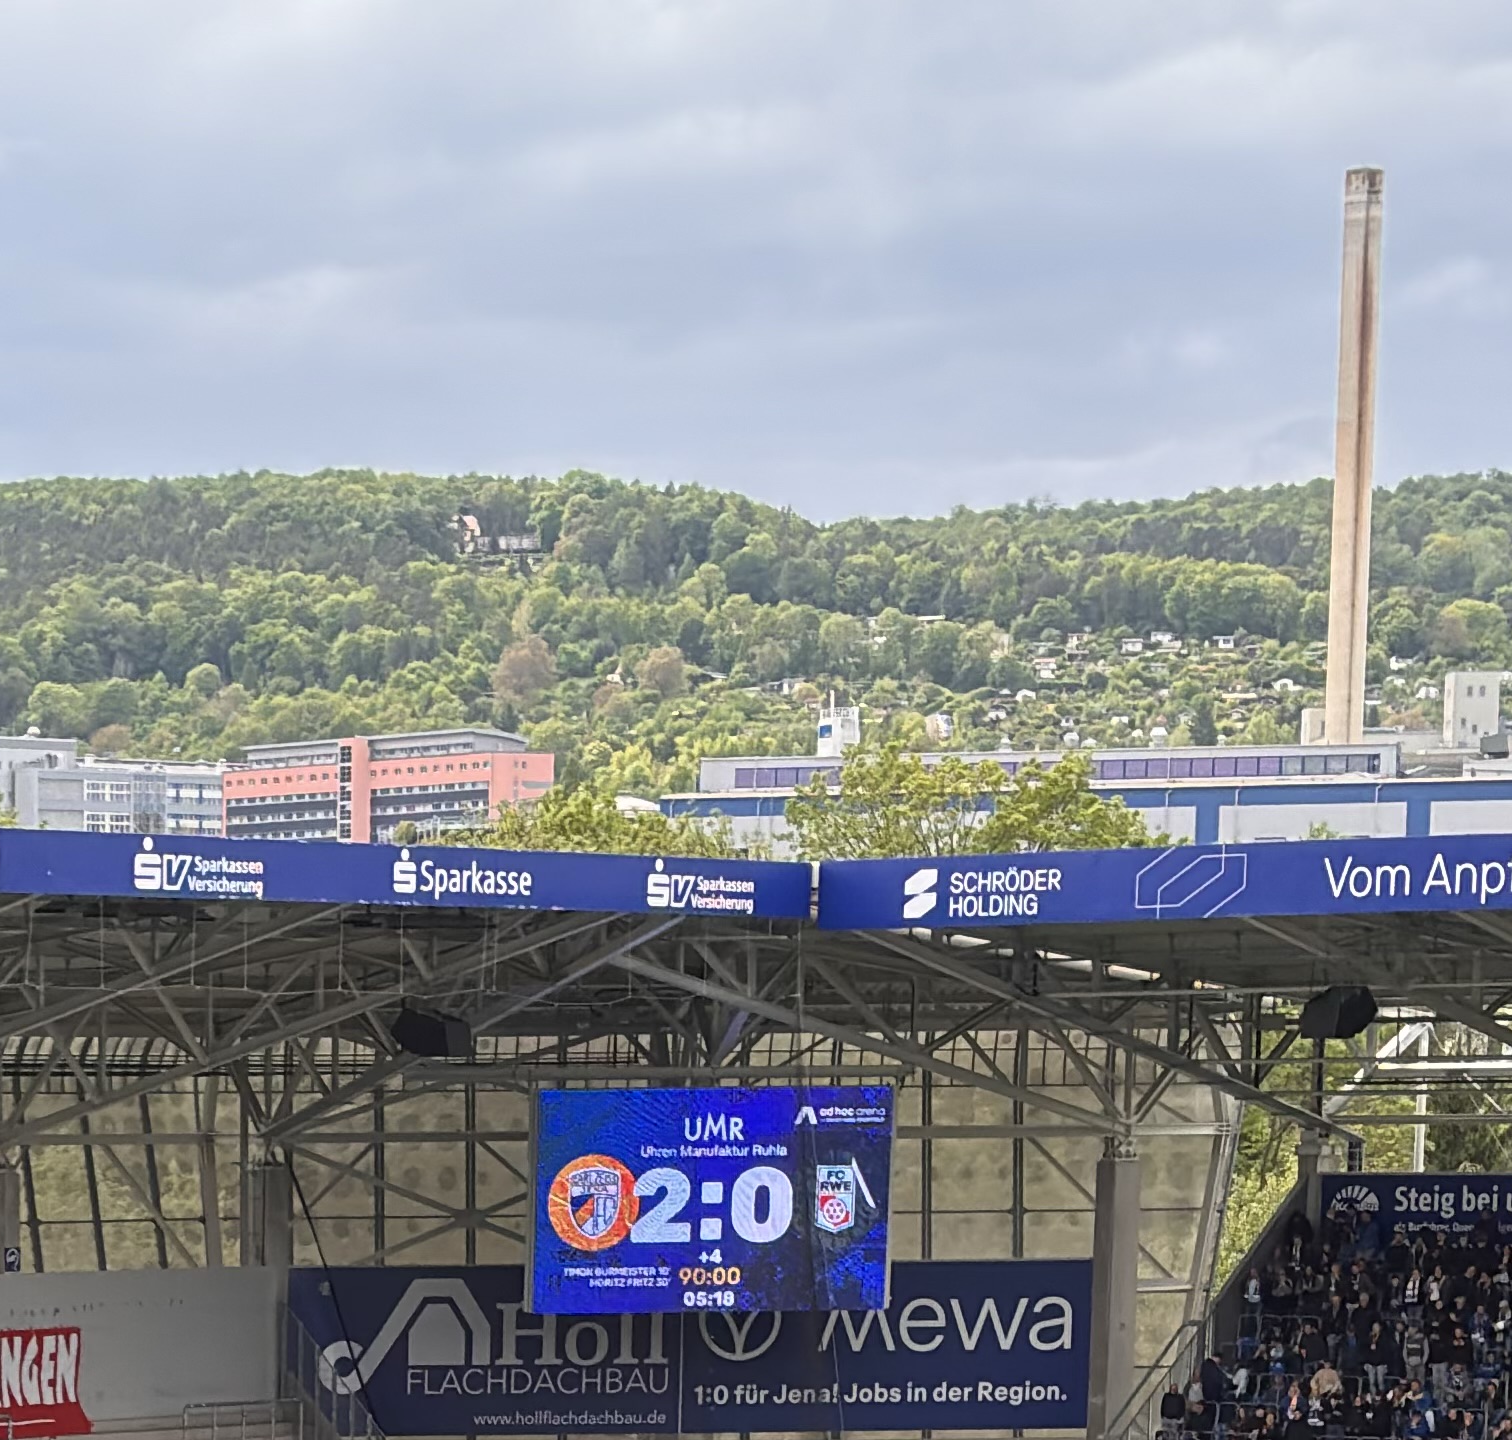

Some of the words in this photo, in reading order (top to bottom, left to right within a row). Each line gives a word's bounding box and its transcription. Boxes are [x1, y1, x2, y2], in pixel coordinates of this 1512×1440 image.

[193, 854, 264, 878] Sparkassen
[949, 865, 1061, 894] SCHRÖDER
[1324, 856, 1413, 899] Vom
[187, 874, 264, 898] Versicherung
[420, 859, 532, 902] Sparkasse
[695, 875, 755, 896] Sparkassen
[691, 893, 754, 915] Versicherung
[948, 890, 1038, 919] HOLDING
[684, 1113, 744, 1141] UMR
[630, 1167, 794, 1243] 2:0
[1394, 1186, 1455, 1220] Steig
[1461, 1185, 1498, 1211] bei
[699, 1249, 722, 1264] +4
[679, 1267, 741, 1285] 90:00
[495, 1304, 668, 1366] Holl
[406, 1367, 670, 1396] FLACHDACHBAU
[693, 1384, 729, 1406] 1:0
[734, 1382, 766, 1404] für
[773, 1382, 838, 1405] Jena!
[844, 1382, 898, 1404] Jobs
[904, 1382, 928, 1402] in
[933, 1380, 972, 1401] der
[978, 1380, 1069, 1405] Region.
[473, 1409, 667, 1428] www.hollflachdachbau.de
